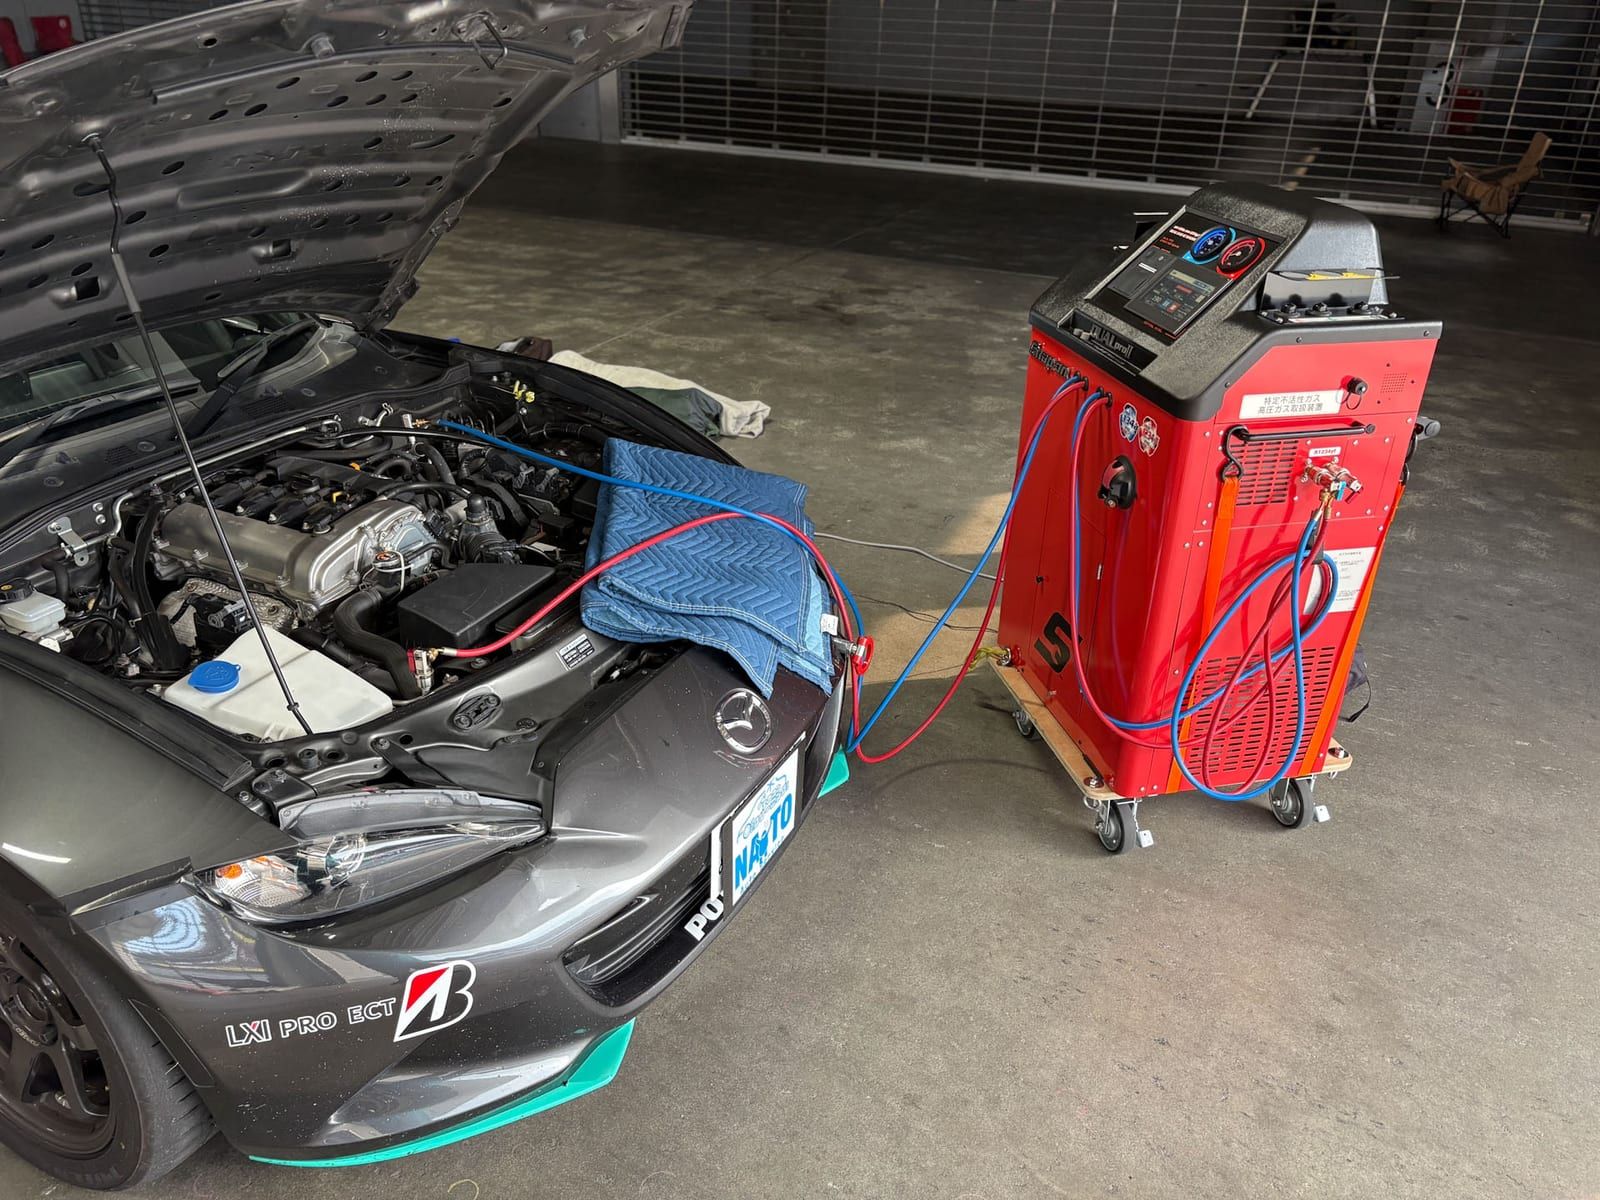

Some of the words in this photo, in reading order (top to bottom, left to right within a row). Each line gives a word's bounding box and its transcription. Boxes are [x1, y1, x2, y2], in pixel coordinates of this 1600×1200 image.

[225, 1018, 272, 1048] LXI
[279, 1011, 338, 1039] PRO
[347, 997, 397, 1025] ECT
